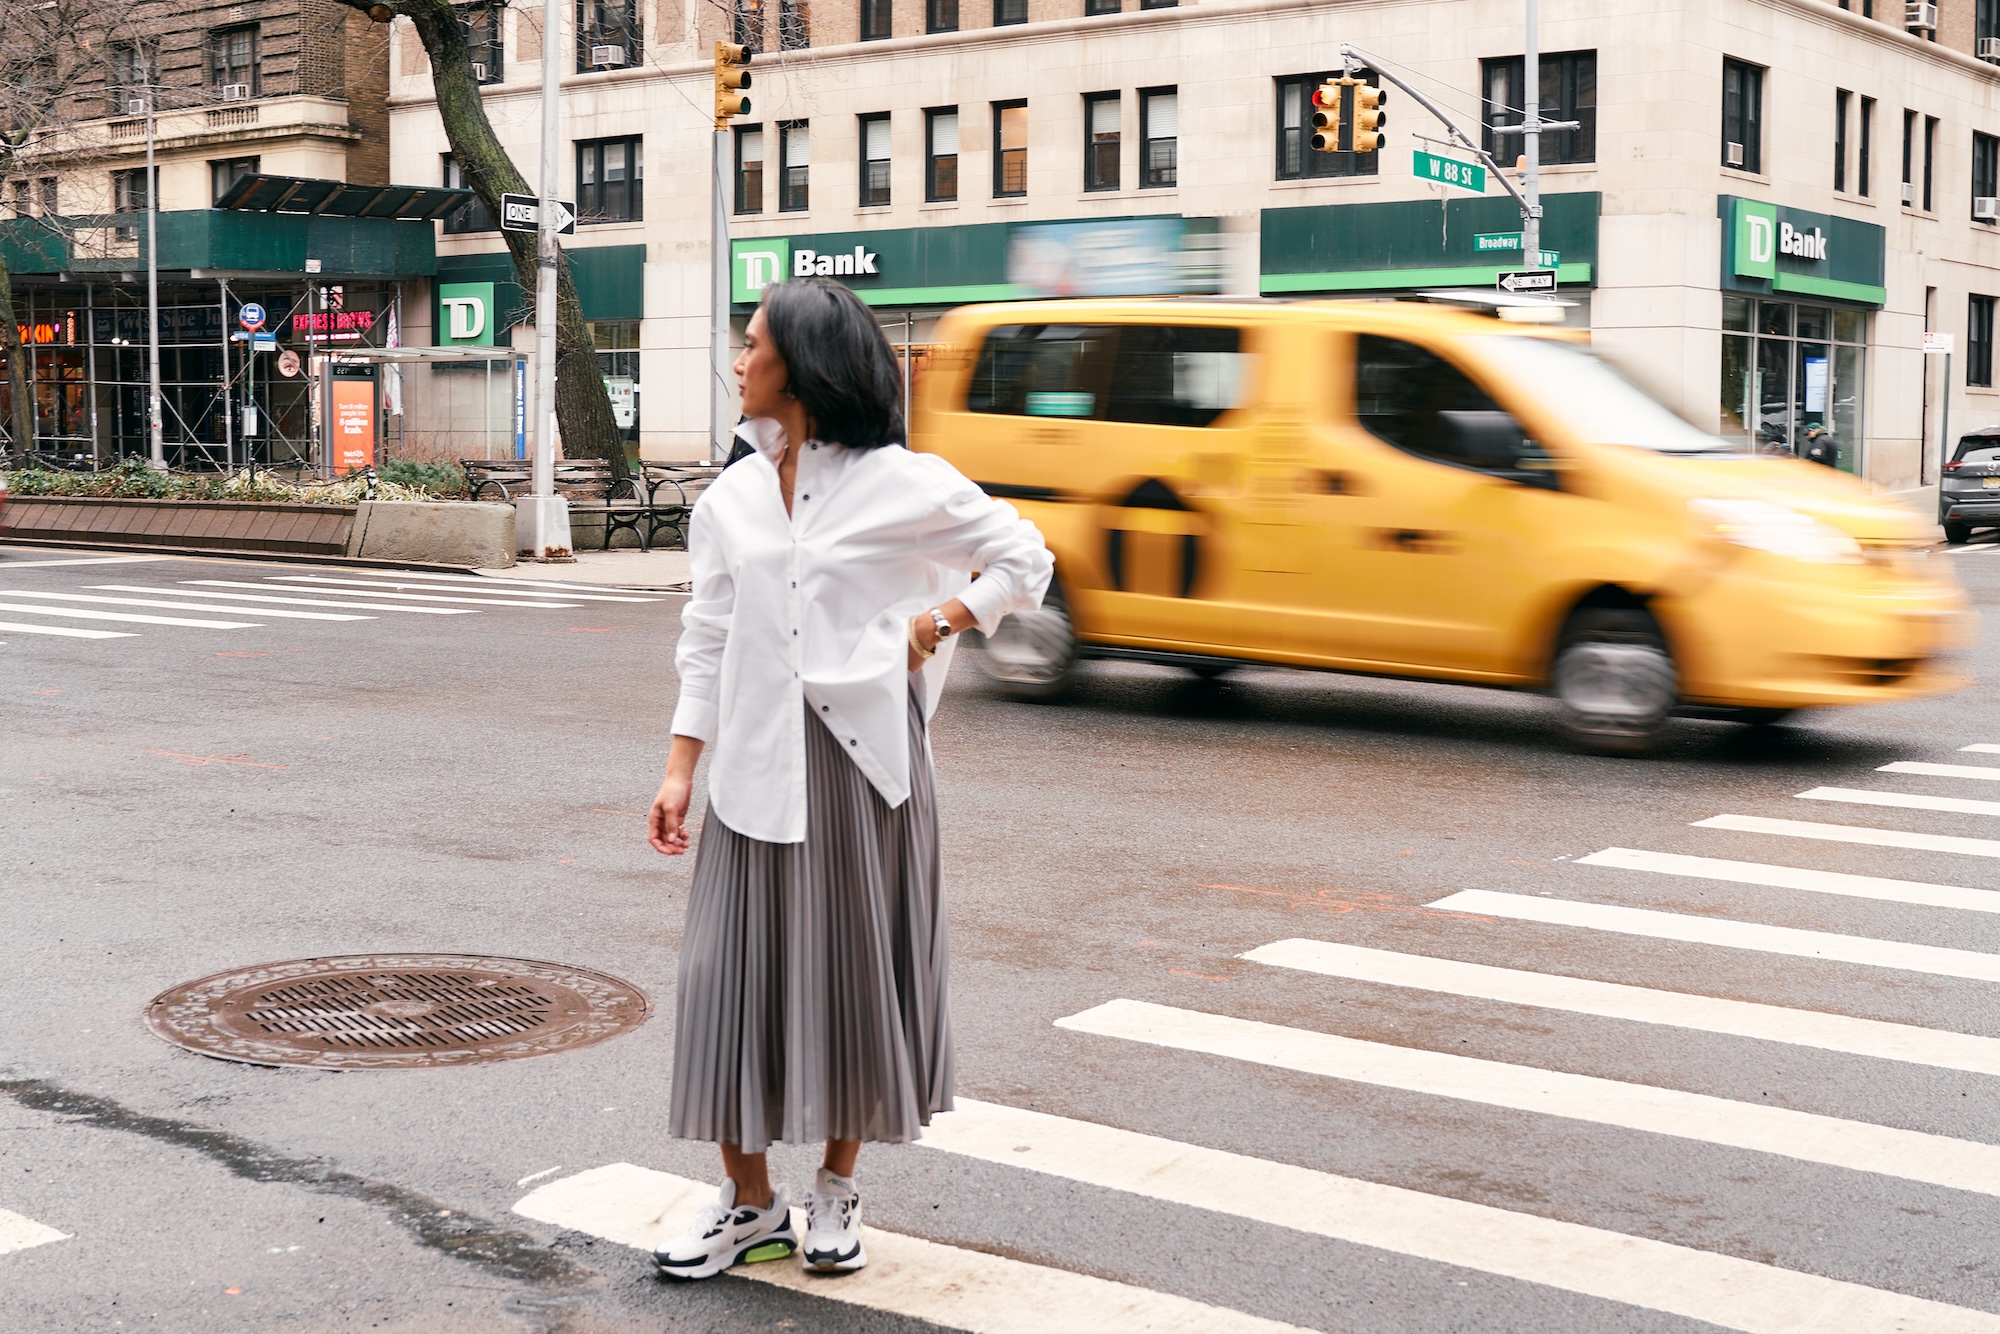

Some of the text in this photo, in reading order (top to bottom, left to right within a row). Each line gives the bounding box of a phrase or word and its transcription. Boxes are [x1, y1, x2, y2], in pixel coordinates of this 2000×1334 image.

[1429, 158, 1472, 185] W 88 St
[509, 205, 531, 220] ONE
[1479, 237, 1518, 250] Broadway
[1745, 214, 1828, 264] TD Bank
[1543, 252, 1552, 266] 88
[737, 245, 880, 290] TD Bank
[1506, 277, 1548, 288] ONE WAY
[293, 313, 335, 331] EXPRESS
[441, 296, 485, 339] TD
[339, 417, 368, 426] 8 million
